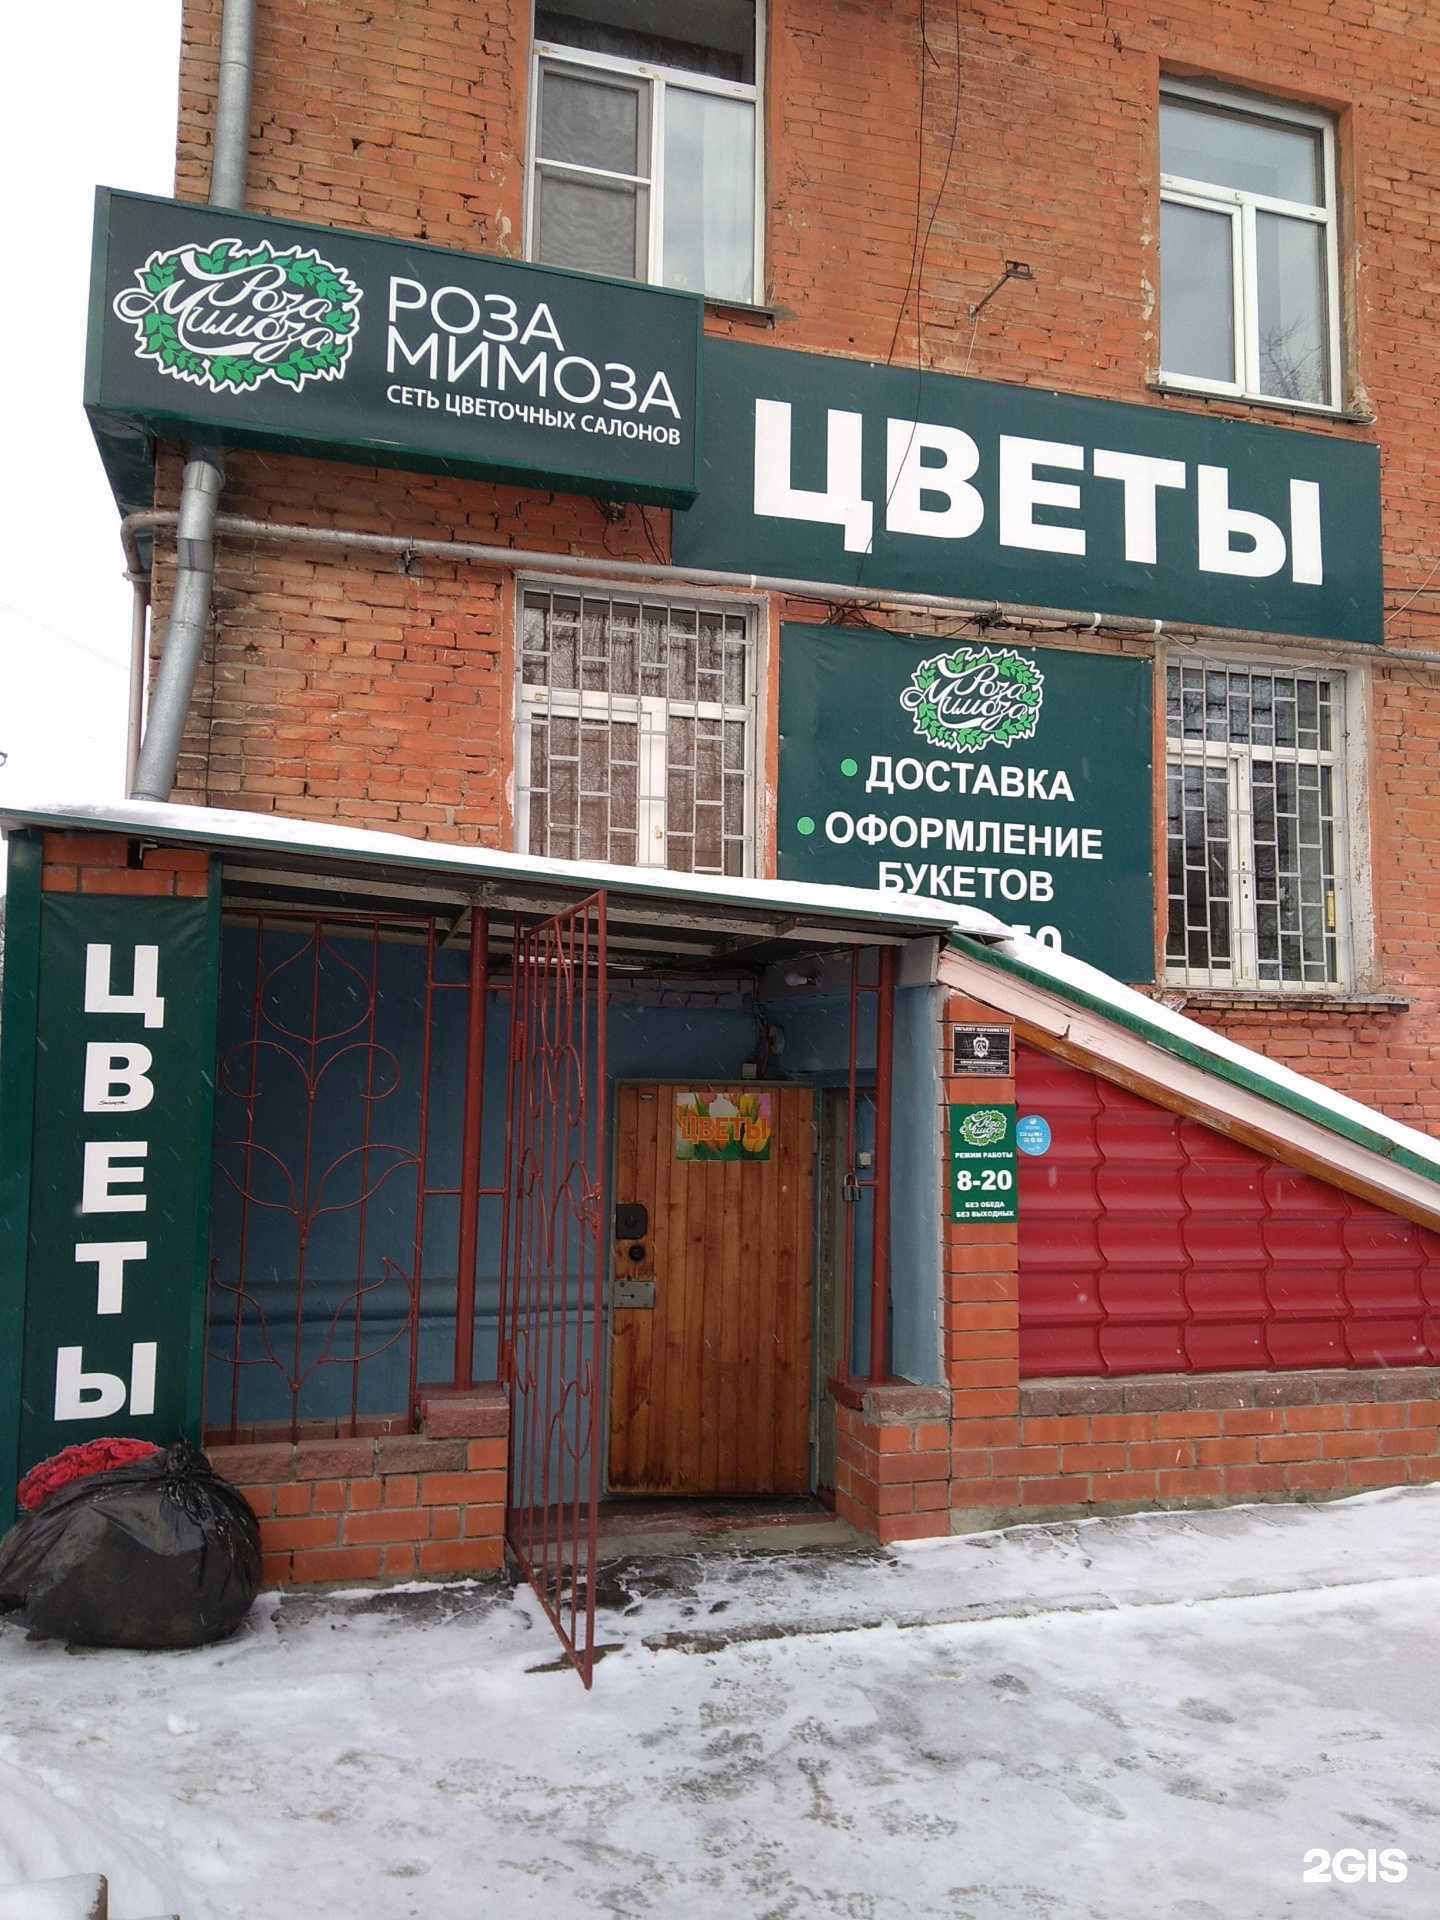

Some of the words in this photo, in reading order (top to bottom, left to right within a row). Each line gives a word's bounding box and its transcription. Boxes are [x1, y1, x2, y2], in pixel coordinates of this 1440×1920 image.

[388, 275, 565, 352] РОЗА
[386, 324, 681, 419] МИМОЗА
[386, 384, 440, 409] СЕТЬ
[445, 393, 576, 431] ЦВЕТОЧНЫХ
[580, 414, 681, 445] САЛОНОВ
[754, 398, 1323, 586] ЦВЕТЫ
[865, 755, 1075, 802] ДОСТАВКА
[825, 811, 1103, 860] ОФОРМЛЕНИЕ
[879, 861, 1054, 902] БУКЕТОВ
[680, 1115, 768, 1144] ЦВЕТЫ
[54, 943, 165, 1421] ЦВЕТЫ
[957, 1169, 1013, 1191] 8-20
[971, 1210, 1015, 1218] ВЫХОДНЫХ
